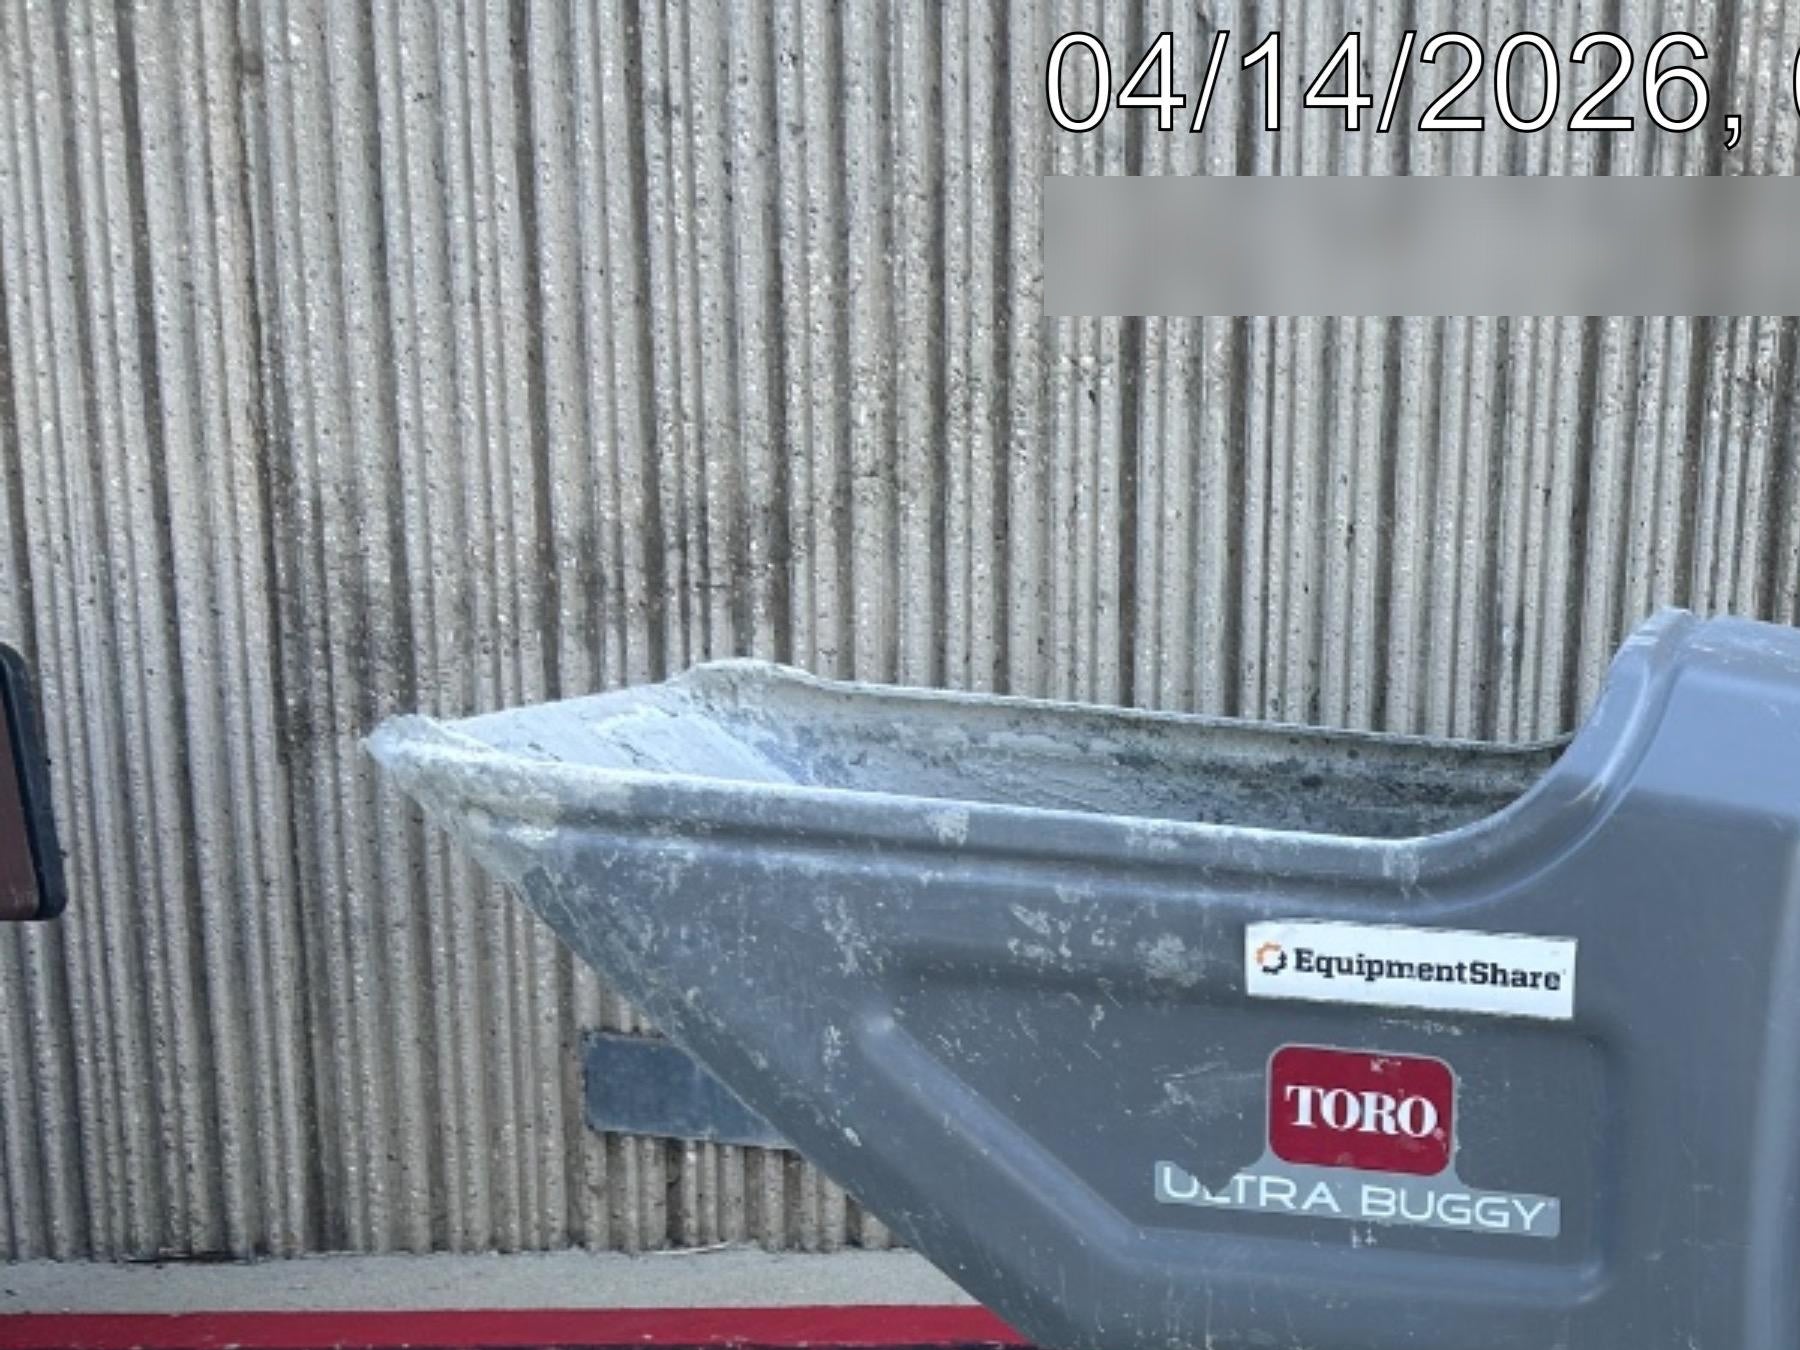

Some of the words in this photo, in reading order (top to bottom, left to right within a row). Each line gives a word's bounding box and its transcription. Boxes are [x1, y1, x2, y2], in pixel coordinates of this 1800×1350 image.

[1294, 948, 1562, 992] EquipmentShare
[1284, 1084, 1439, 1139] TORO
[1361, 1184, 1547, 1231] BUGGY
